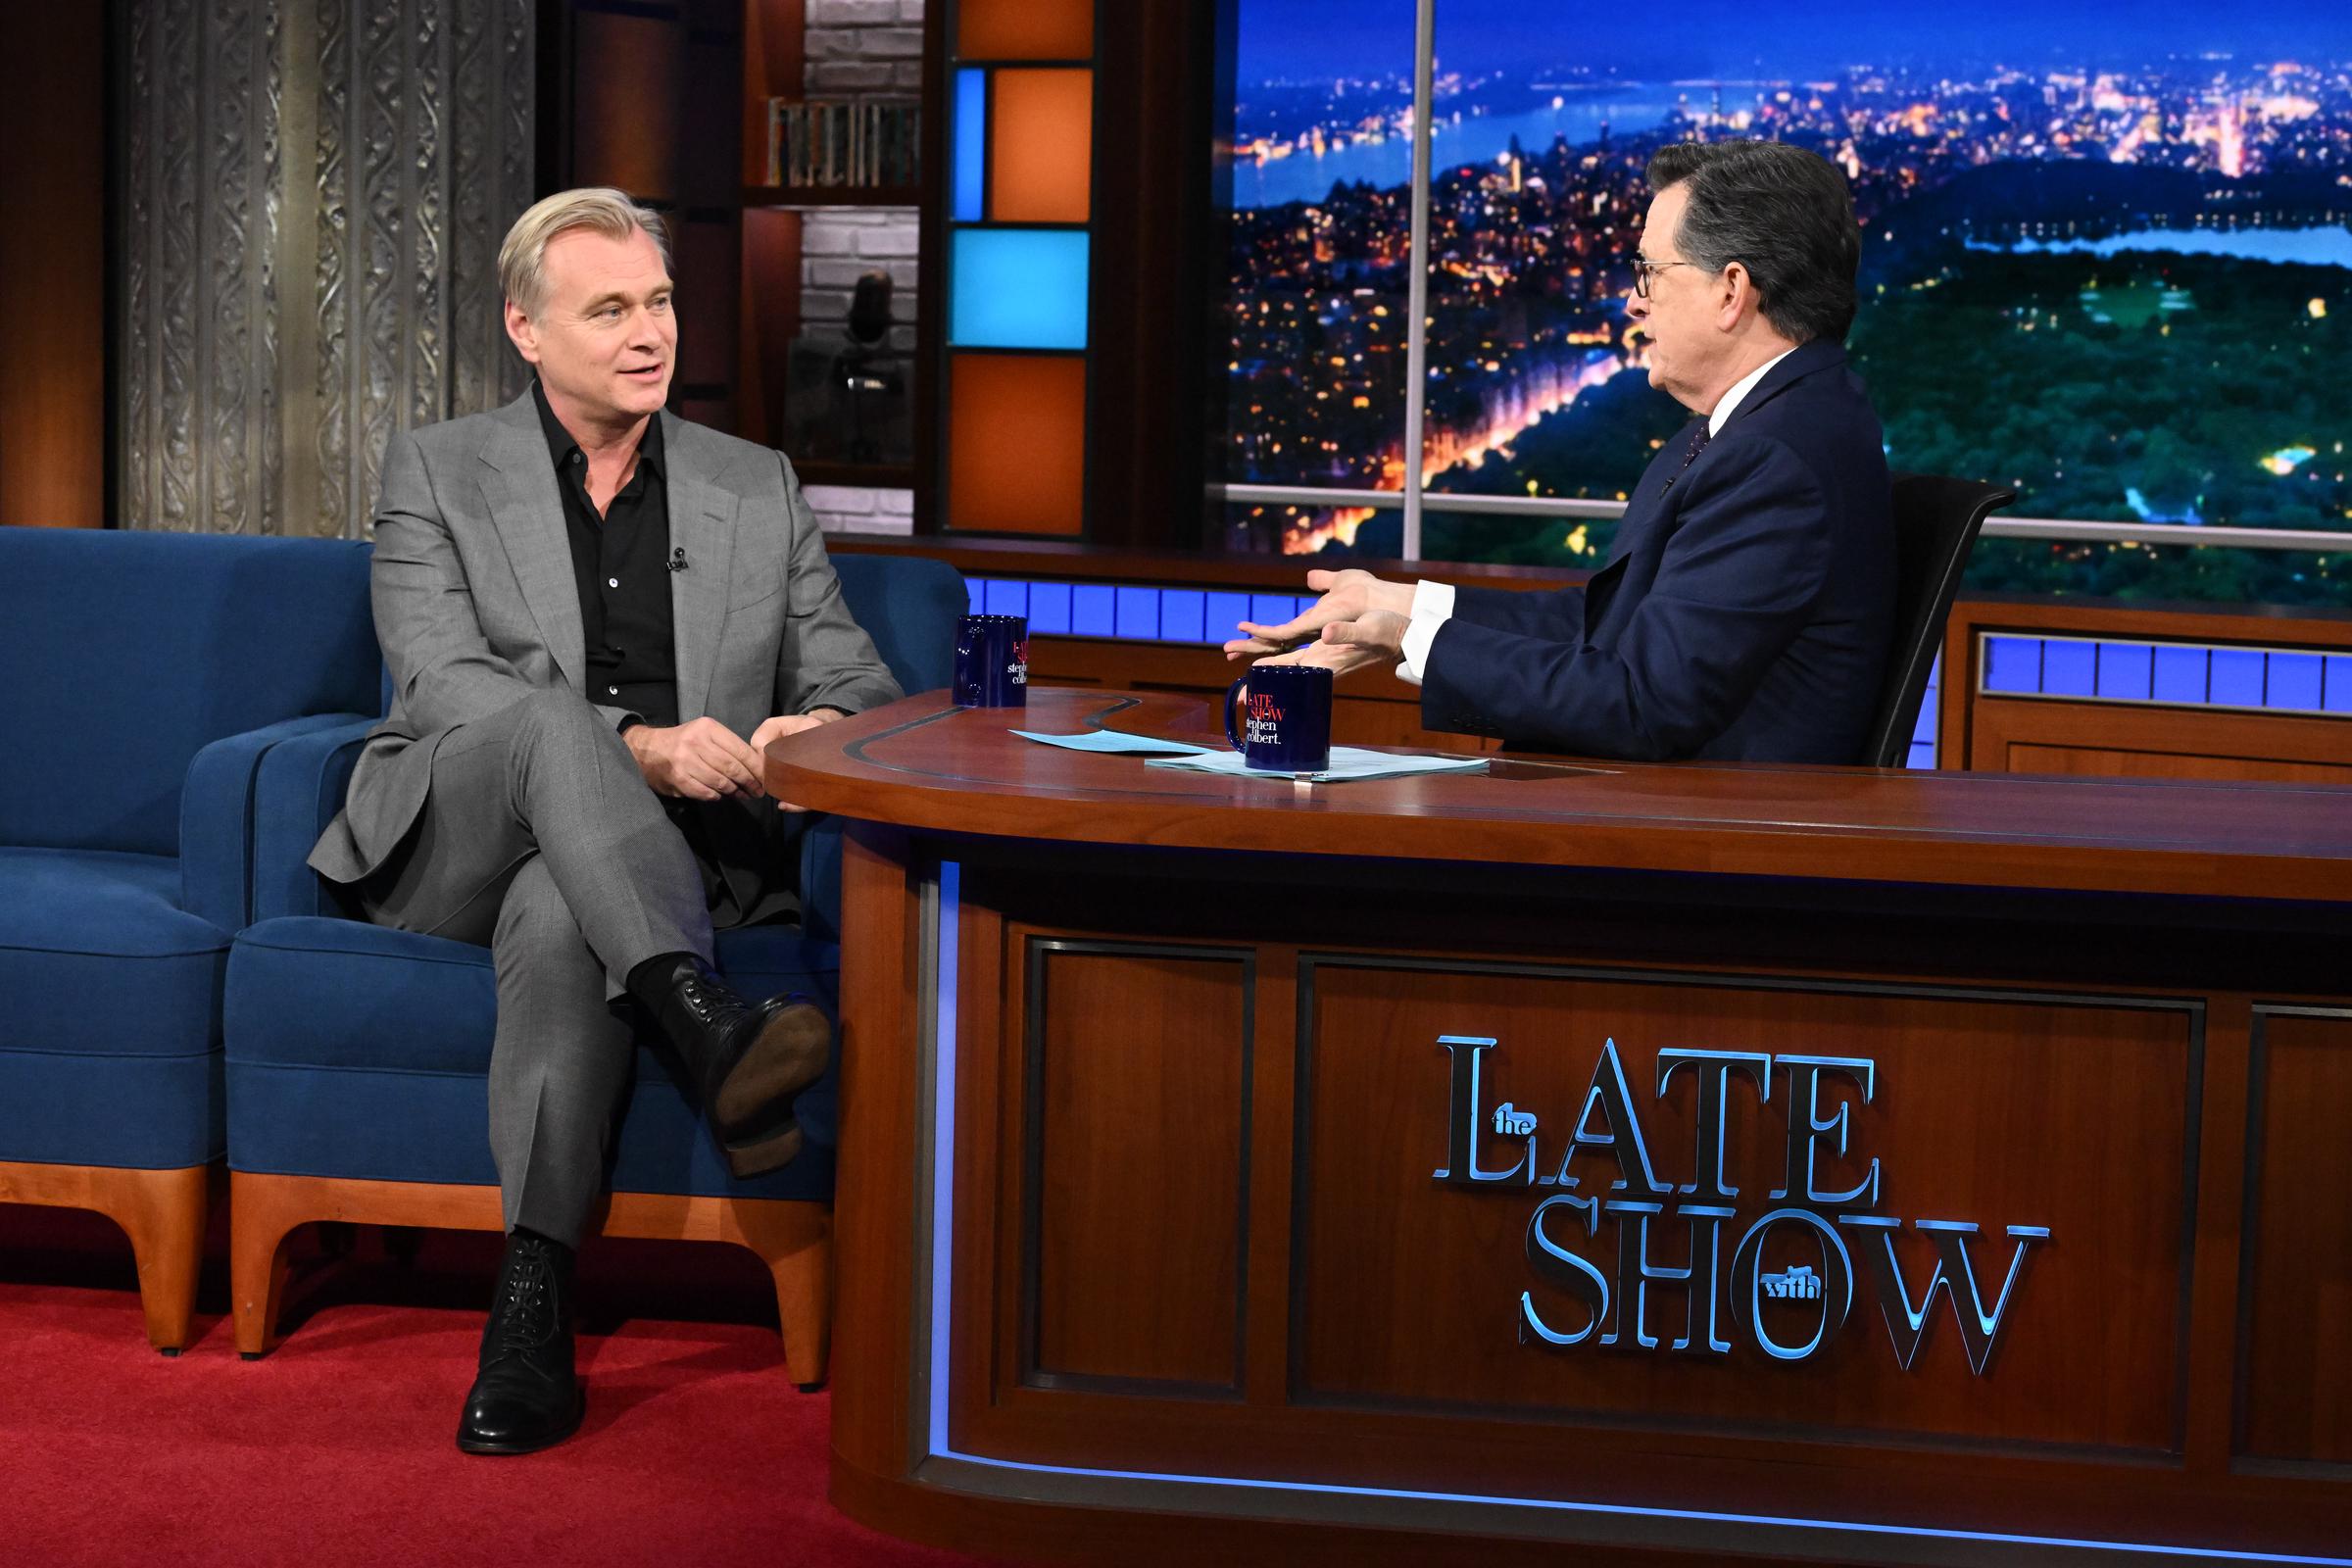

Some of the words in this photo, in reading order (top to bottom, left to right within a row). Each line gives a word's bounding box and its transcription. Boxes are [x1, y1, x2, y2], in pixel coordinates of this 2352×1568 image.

[1248, 691, 1274, 708] LATE
[1250, 706, 1286, 721] SHOW
[1432, 1035, 1881, 1208] LATE
[1492, 1102, 1537, 1135] the
[1518, 1193, 2050, 1376] SHOW
[1760, 1265, 1821, 1299] with
